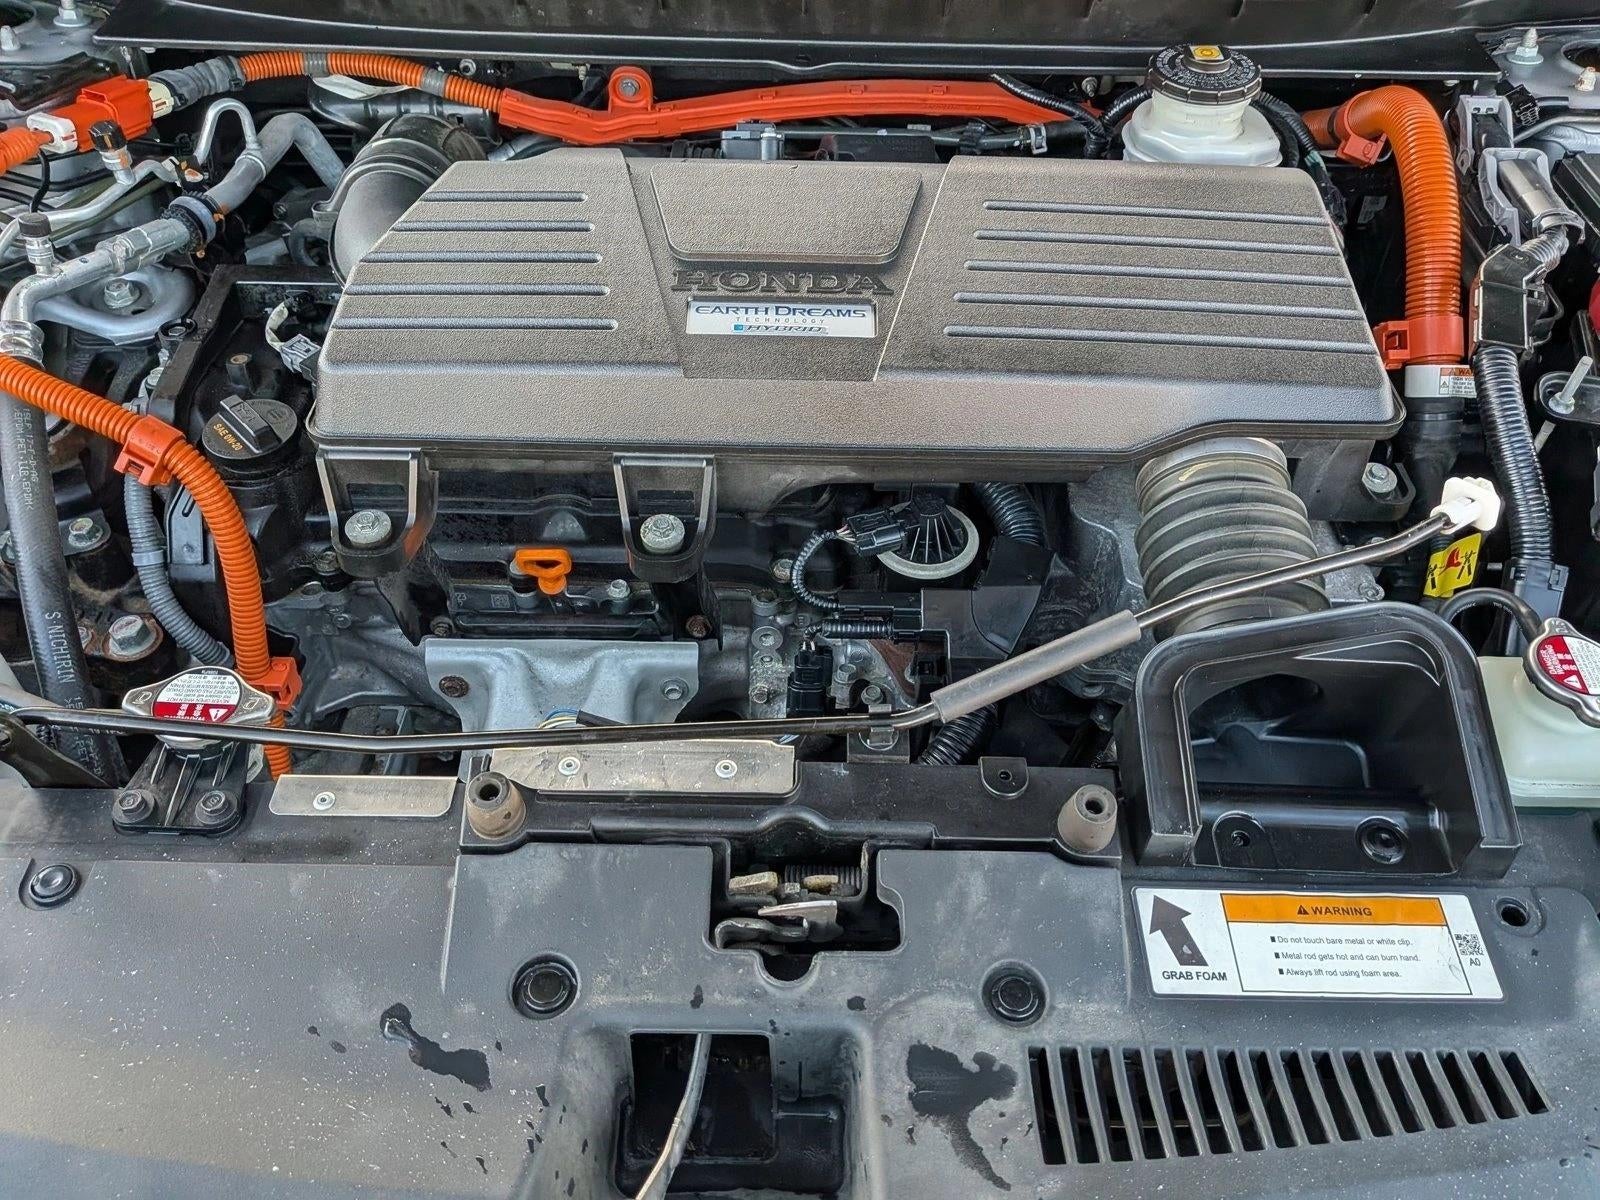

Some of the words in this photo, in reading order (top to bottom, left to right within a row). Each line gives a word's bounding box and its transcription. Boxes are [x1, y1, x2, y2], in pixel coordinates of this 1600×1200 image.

[670, 269, 894, 295] HONDA
[695, 305, 769, 316] EARTH
[774, 305, 867, 318] DREAMS
[736, 316, 826, 325] TECHNOLOGY
[746, 324, 823, 333] HYBRID
[213, 423, 228, 436] SAE
[1311, 906, 1373, 917] WARNING
[1291, 936, 1301, 944] not
[1303, 936, 1325, 944] touch
[1327, 936, 1343, 945] bare
[1345, 937, 1365, 945] metal
[1397, 938, 1413, 946] clip.
[1303, 952, 1317, 960] rod
[1318, 953, 1335, 961] gets
[1350, 953, 1364, 961] and
[1381, 953, 1398, 961] burn
[1162, 970, 1194, 981] GRAB
[1196, 971, 1228, 981] FOAM
[1286, 968, 1313, 977] Always
[1314, 968, 1324, 976] lift
[1339, 969, 1360, 978] using
[1361, 969, 1381, 977] foam
[1383, 970, 1402, 978] area.
